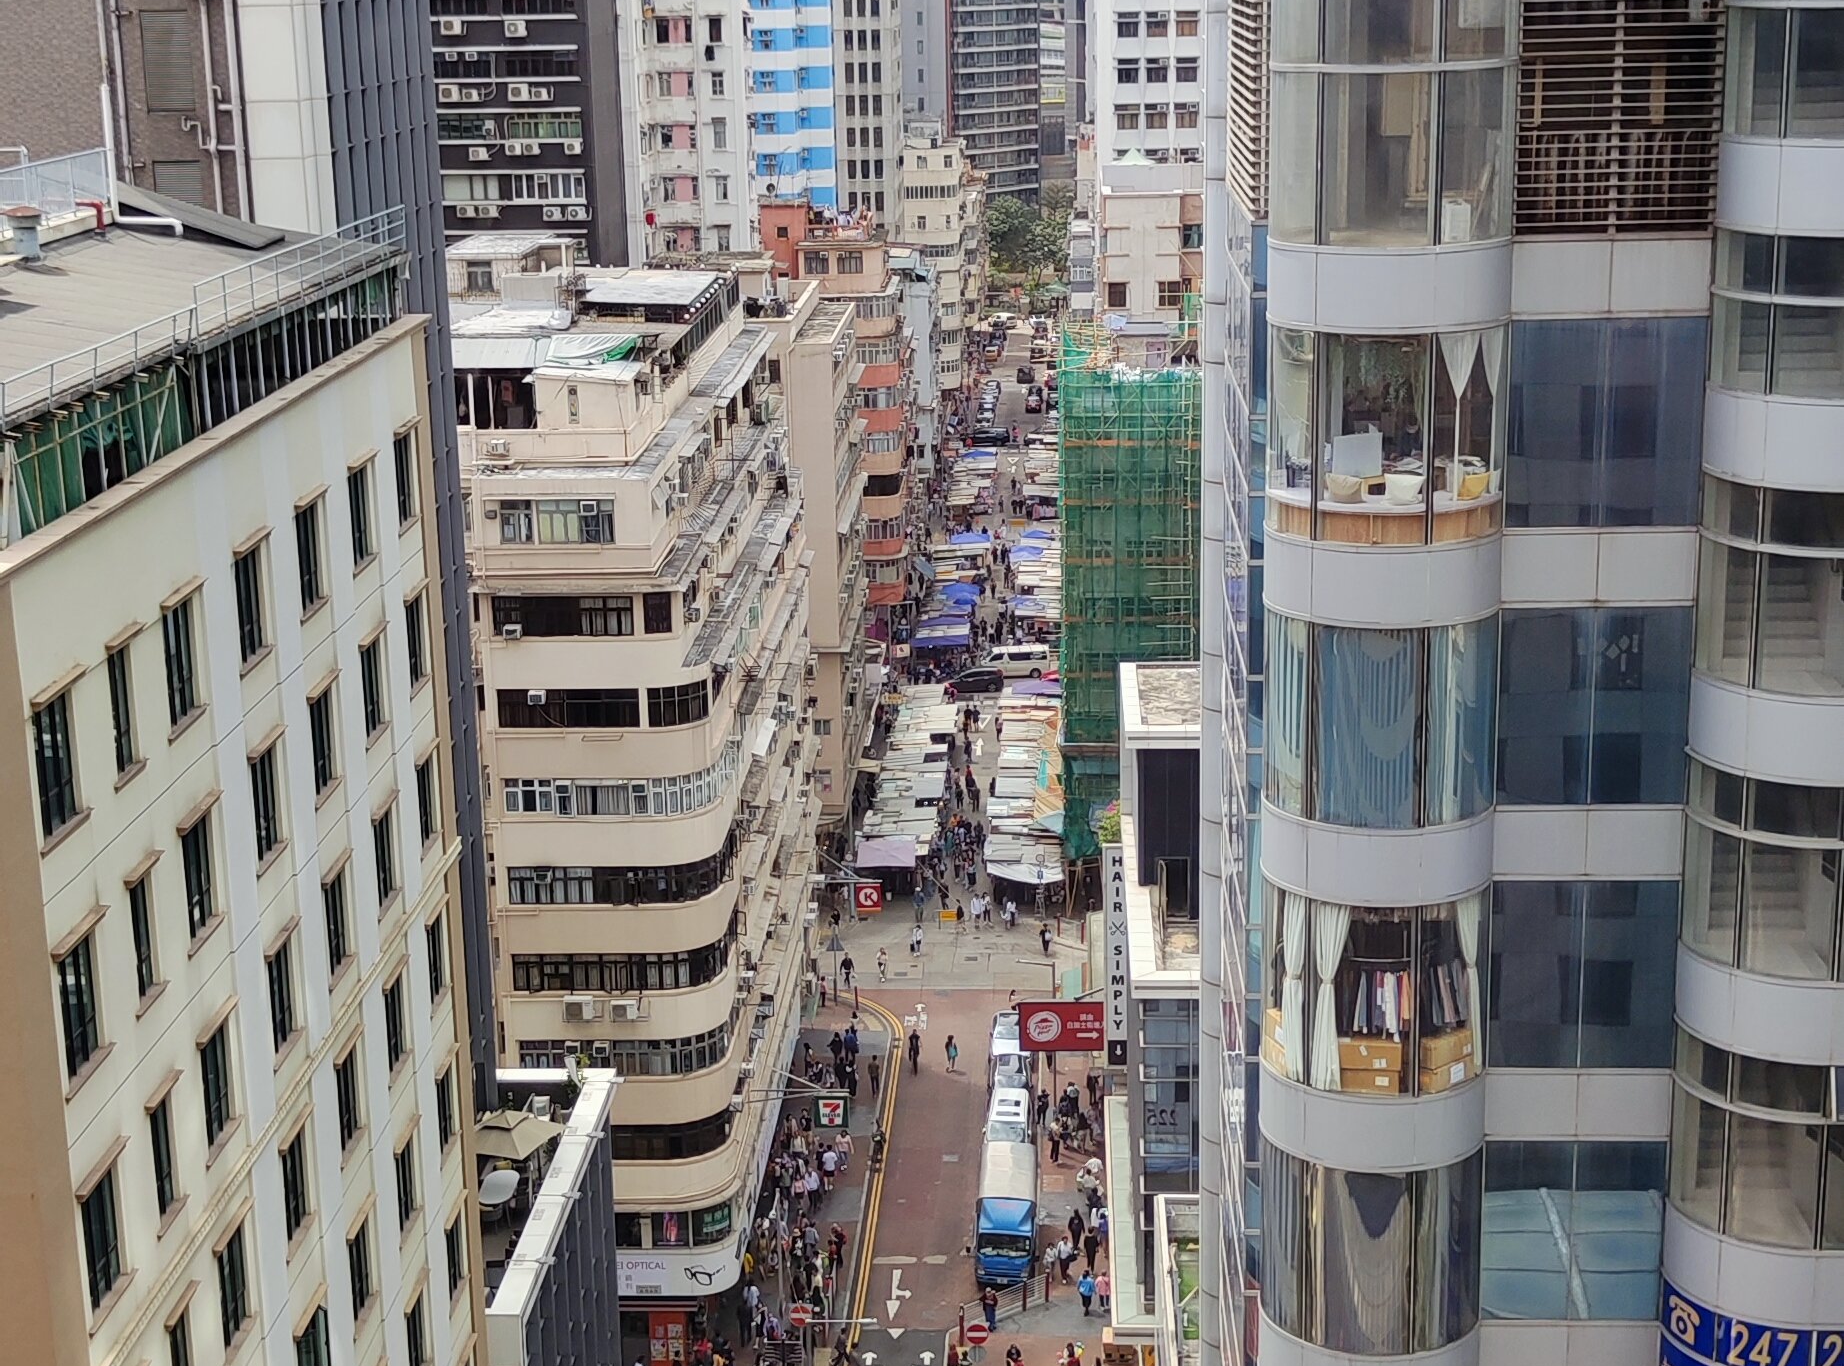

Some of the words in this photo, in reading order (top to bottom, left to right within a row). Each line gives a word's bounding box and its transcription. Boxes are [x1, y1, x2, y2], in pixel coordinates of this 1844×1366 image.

[1111, 856, 1123, 913] HAIR
[1111, 945, 1125, 1031] SIMPLY
[626, 1261, 667, 1270] OPTICAL
